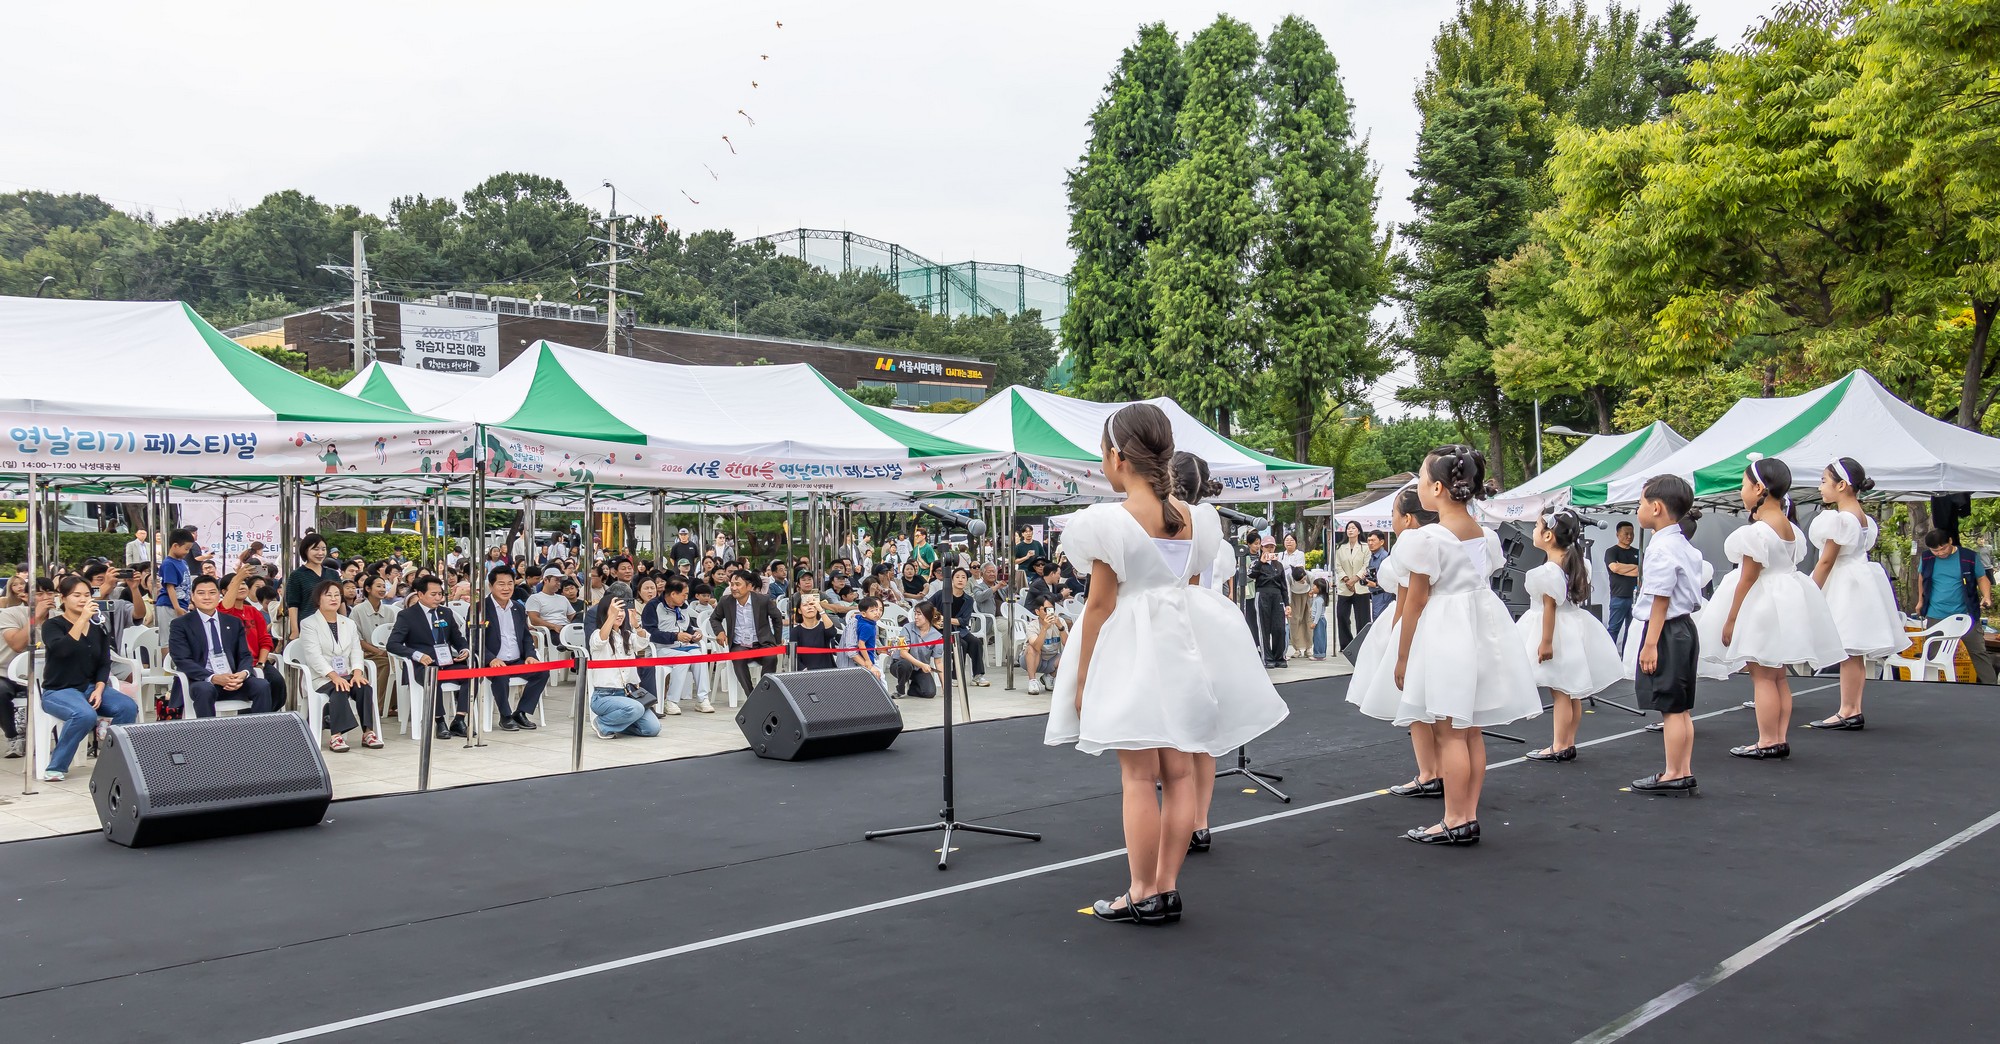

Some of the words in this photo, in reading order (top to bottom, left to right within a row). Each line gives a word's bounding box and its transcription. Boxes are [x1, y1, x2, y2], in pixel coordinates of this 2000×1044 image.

[421, 327, 461, 341] 2026년
[463, 331, 479, 343] 2월
[415, 340, 445, 353] 학습자
[446, 343, 465, 355] 모집
[466, 345, 486, 357] 예정
[898, 360, 943, 376] 서울시민대학
[10, 426, 136, 456] 연날리기
[143, 432, 258, 460] 페스티벌
[510, 443, 523, 452] 서울
[514, 453, 543, 463] 연날리기
[22, 461, 77, 469] 14:00~17:00
[80, 462, 120, 471] 낙성대공원
[513, 463, 544, 473] 페스티벌
[661, 464, 683, 473] 2026
[686, 460, 720, 479] 서울
[725, 461, 776, 481] 한마음
[778, 463, 842, 481] 연날리기
[843, 462, 903, 481] 페스티벌
[1223, 475, 1260, 491] 페스티벌
[1376, 519, 1392, 528] 운영부
[226, 530, 244, 543] 서울
[246, 530, 274, 543] 한마음
